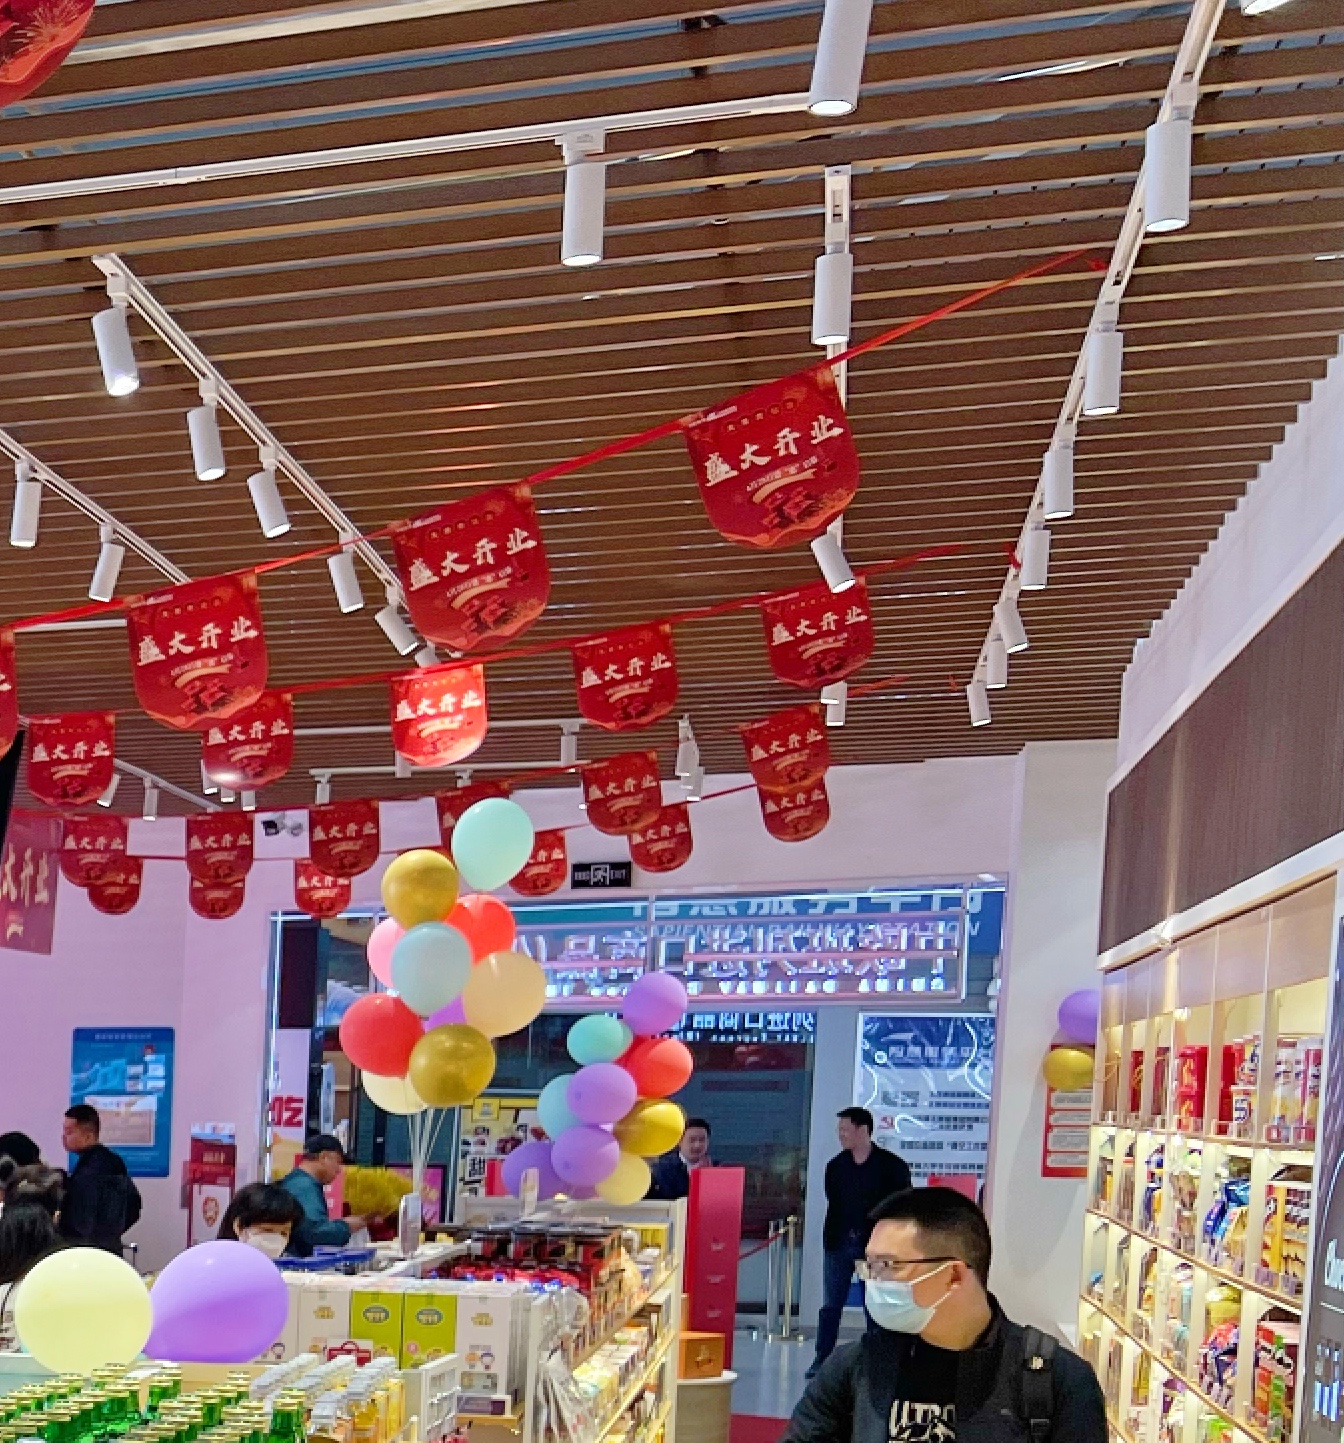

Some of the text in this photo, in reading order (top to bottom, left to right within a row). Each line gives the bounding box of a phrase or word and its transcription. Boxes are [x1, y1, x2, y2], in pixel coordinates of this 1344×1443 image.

[705, 415, 843, 487] 盛大开业
[409, 527, 537, 590] 盛大开业
[137, 615, 258, 667] 盛大开业
[771, 606, 868, 646] 盛大开业
[581, 652, 672, 689] 盛大开业
[395, 691, 481, 722] 盛大开业
[209, 719, 290, 745] 盛大开业
[751, 728, 823, 762] 盛大开业
[30, 741, 111, 763] 盛大开业
[588, 774, 658, 801] 盛大开业
